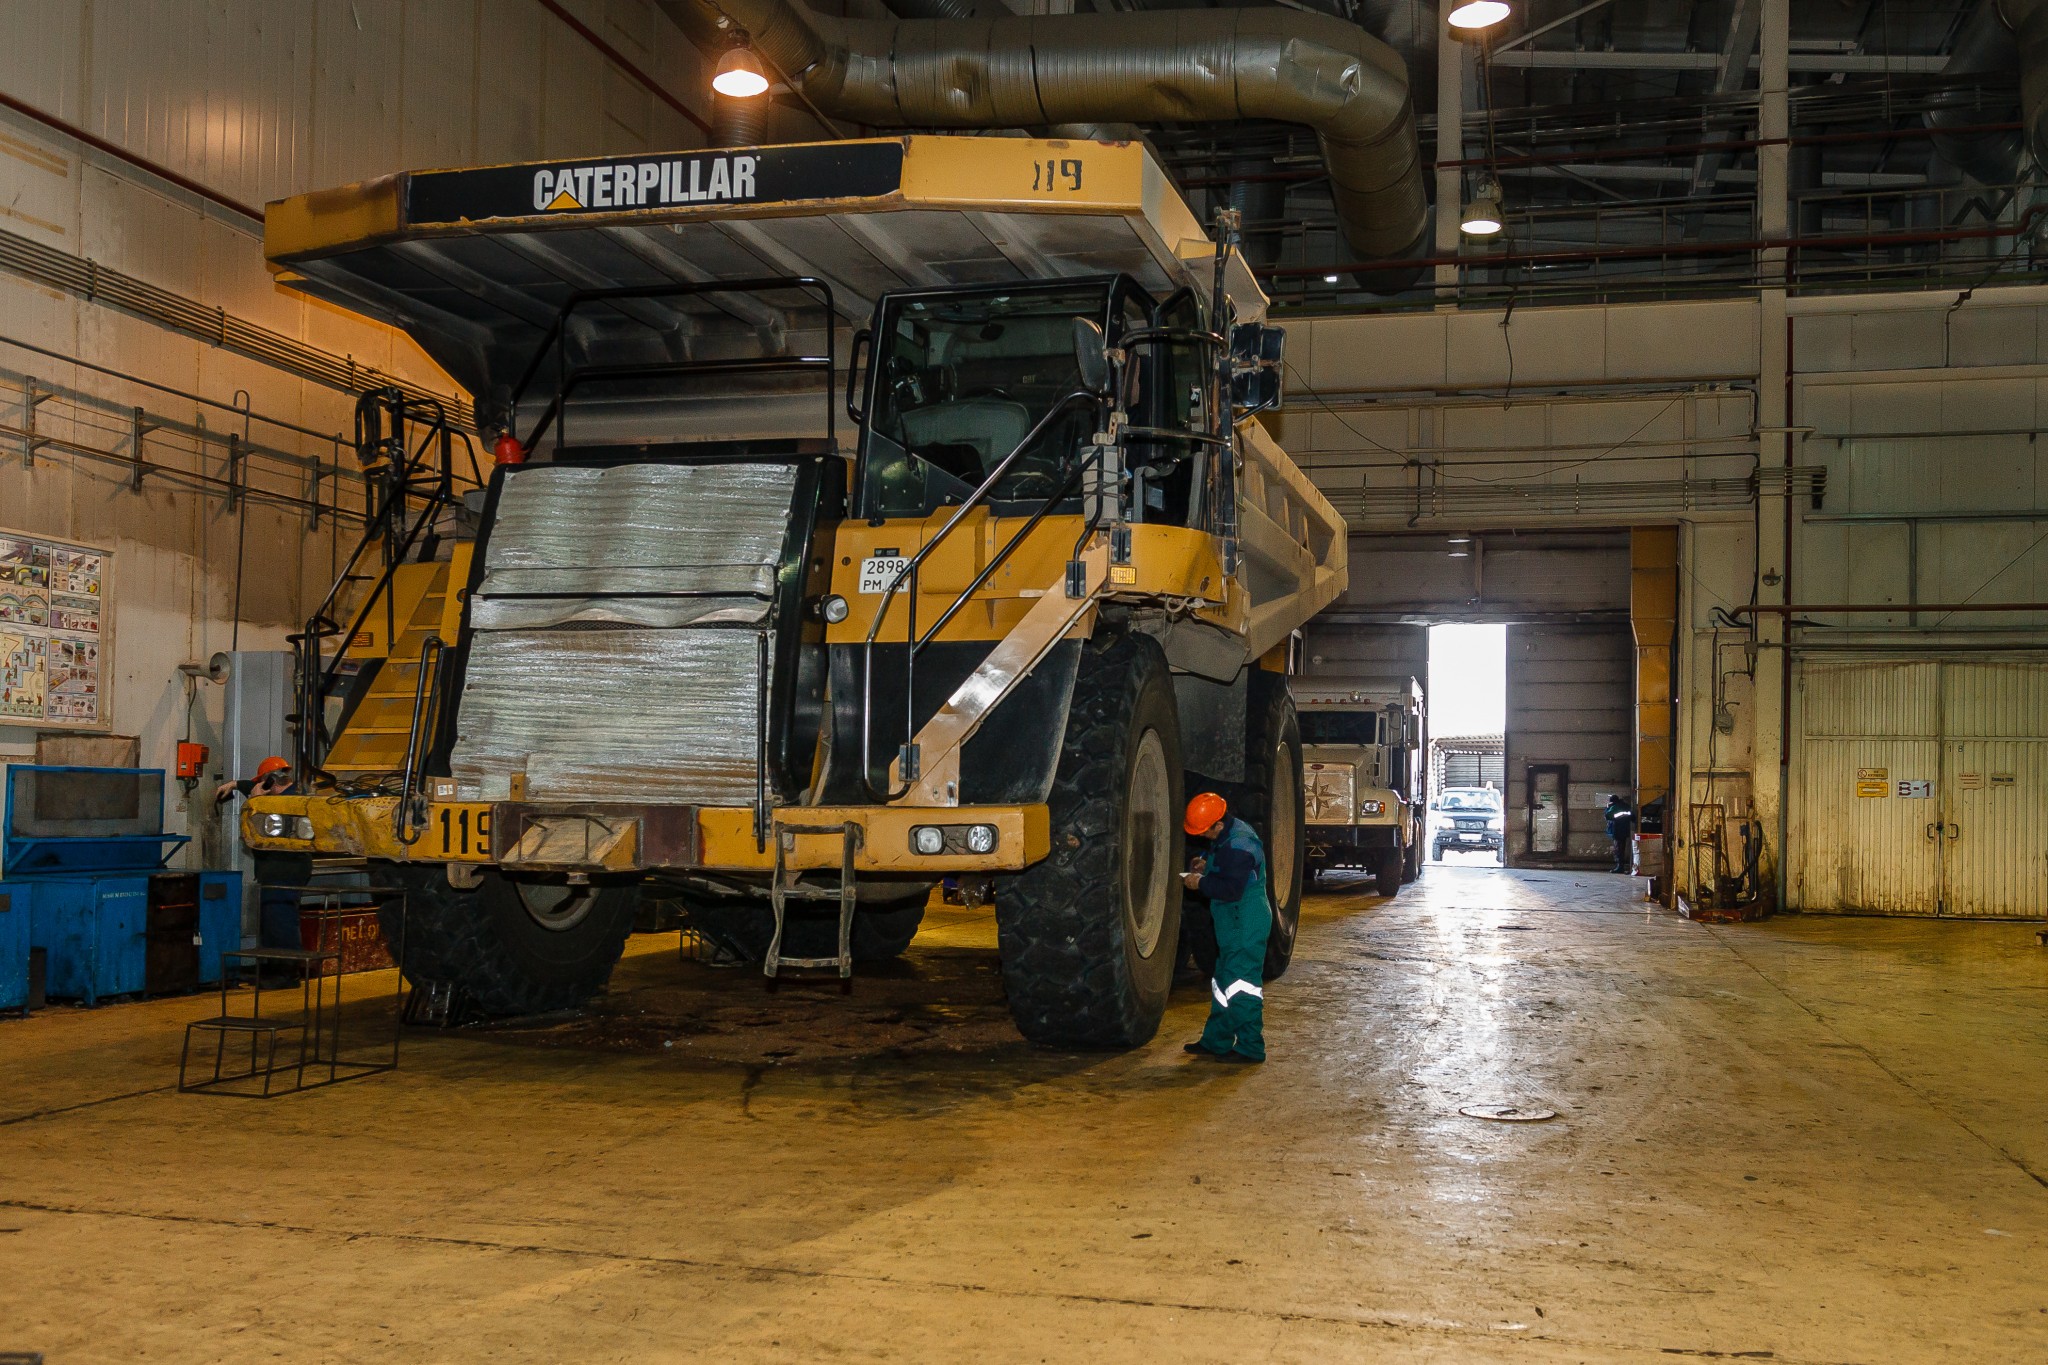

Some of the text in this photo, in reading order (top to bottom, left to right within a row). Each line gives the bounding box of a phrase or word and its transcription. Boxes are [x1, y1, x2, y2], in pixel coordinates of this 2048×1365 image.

[533, 155, 756, 211] CATERPILLAR
[1032, 158, 1083, 192] 119
[867, 560, 904, 574] 2898
